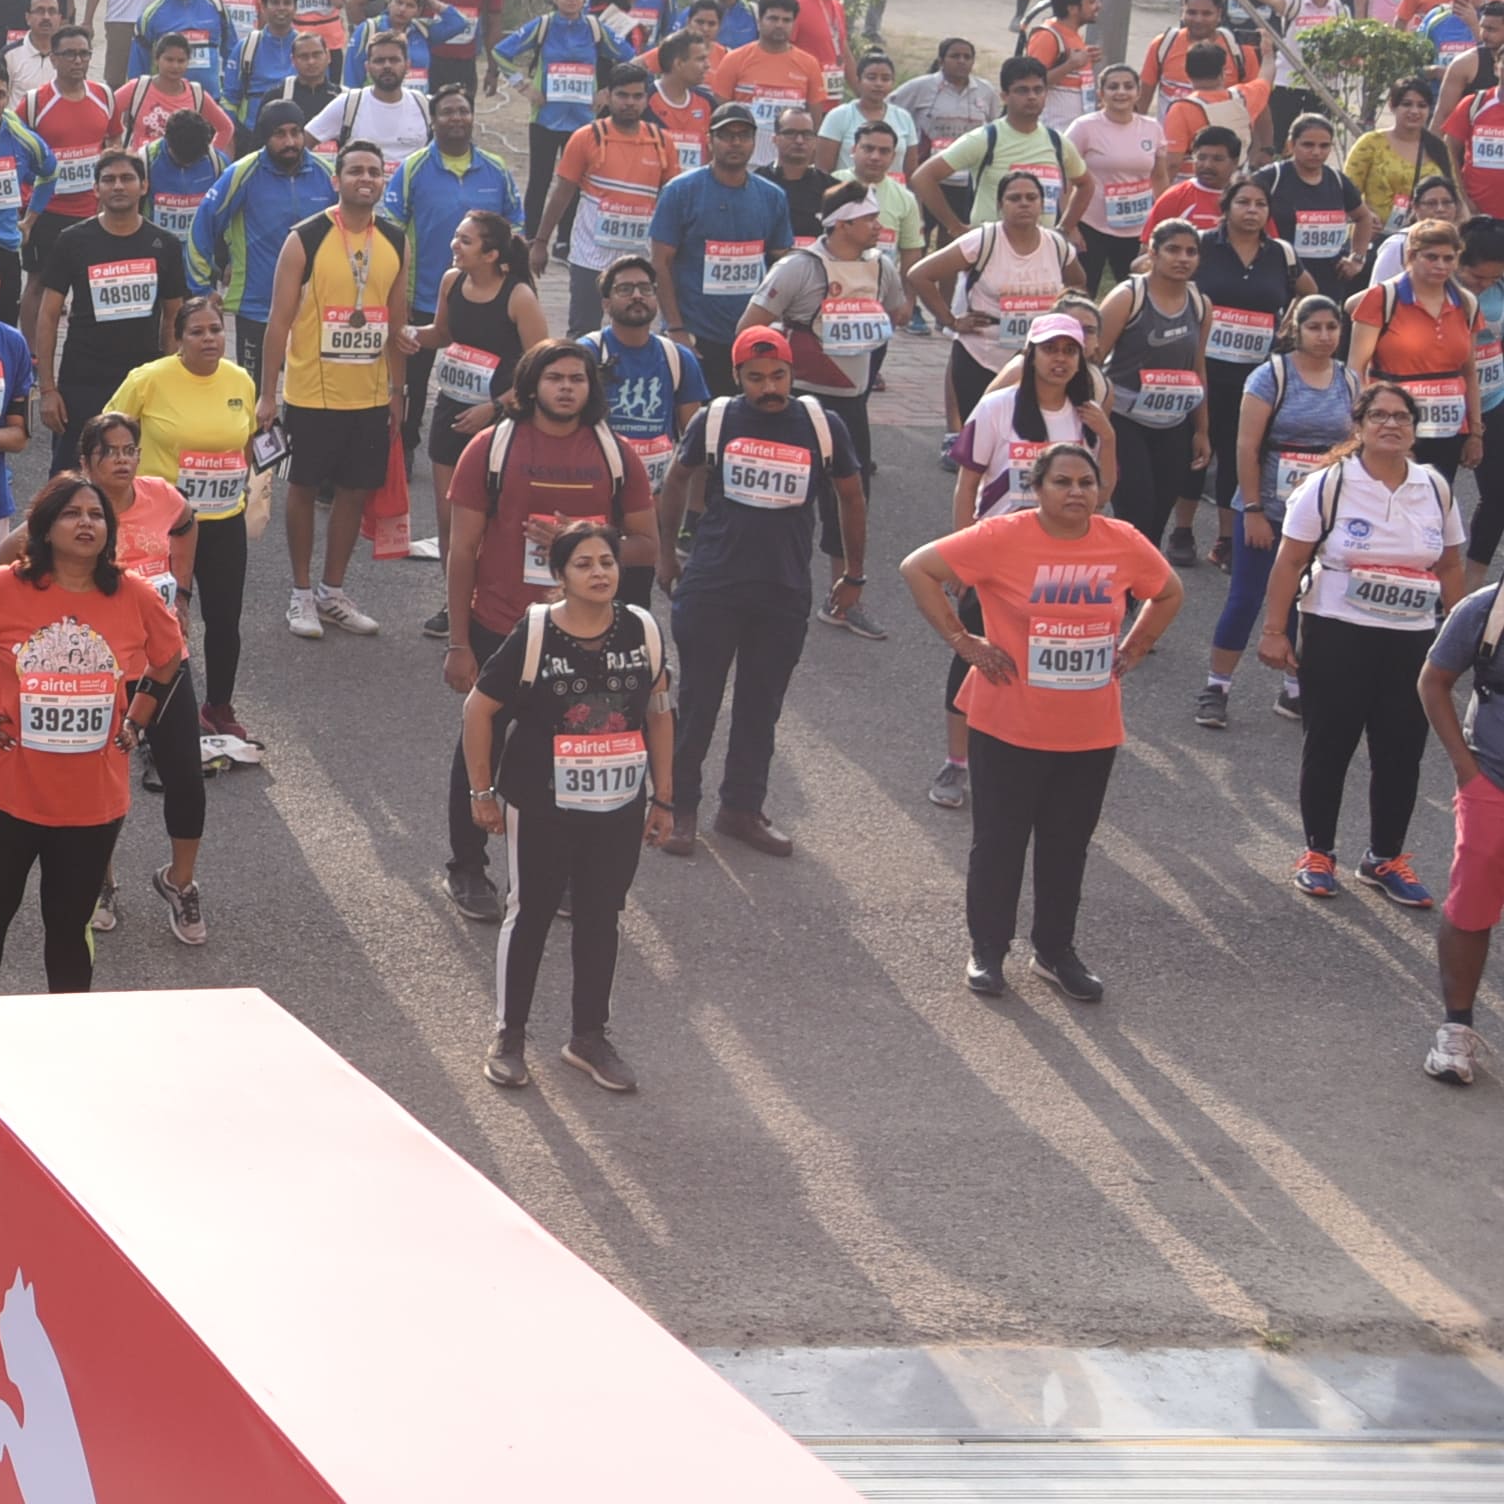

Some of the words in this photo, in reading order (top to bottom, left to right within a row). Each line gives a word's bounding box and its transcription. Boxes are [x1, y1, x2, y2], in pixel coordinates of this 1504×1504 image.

[1307, 211, 1330, 222] airtel
[601, 219, 644, 239] 48116
[1301, 230, 1342, 248] 39847
[718, 243, 742, 255] airtel
[102, 263, 130, 277] airtel
[711, 264, 758, 283] 42338
[98, 282, 152, 306] 48908
[836, 301, 861, 314] airtel
[1222, 310, 1250, 324] airtel
[330, 330, 383, 351] 60258
[829, 321, 883, 343] 49101
[1210, 330, 1264, 352] 40808
[440, 367, 484, 393] 40941
[1156, 371, 1182, 385] airtel
[1411, 384, 1441, 396] airtel
[741, 442, 776, 459] airtel
[194, 455, 223, 469] airtel
[184, 477, 239, 499] 57162
[730, 466, 798, 495] 56416
[1028, 564, 1118, 605] NIKE
[1354, 580, 1427, 610] 40845
[1048, 623, 1085, 637] airtel
[1038, 647, 1108, 673] 40971
[40, 677, 78, 693] airtel
[30, 706, 104, 733] 39236
[574, 739, 611, 755] airtel
[565, 766, 636, 793] 39170
